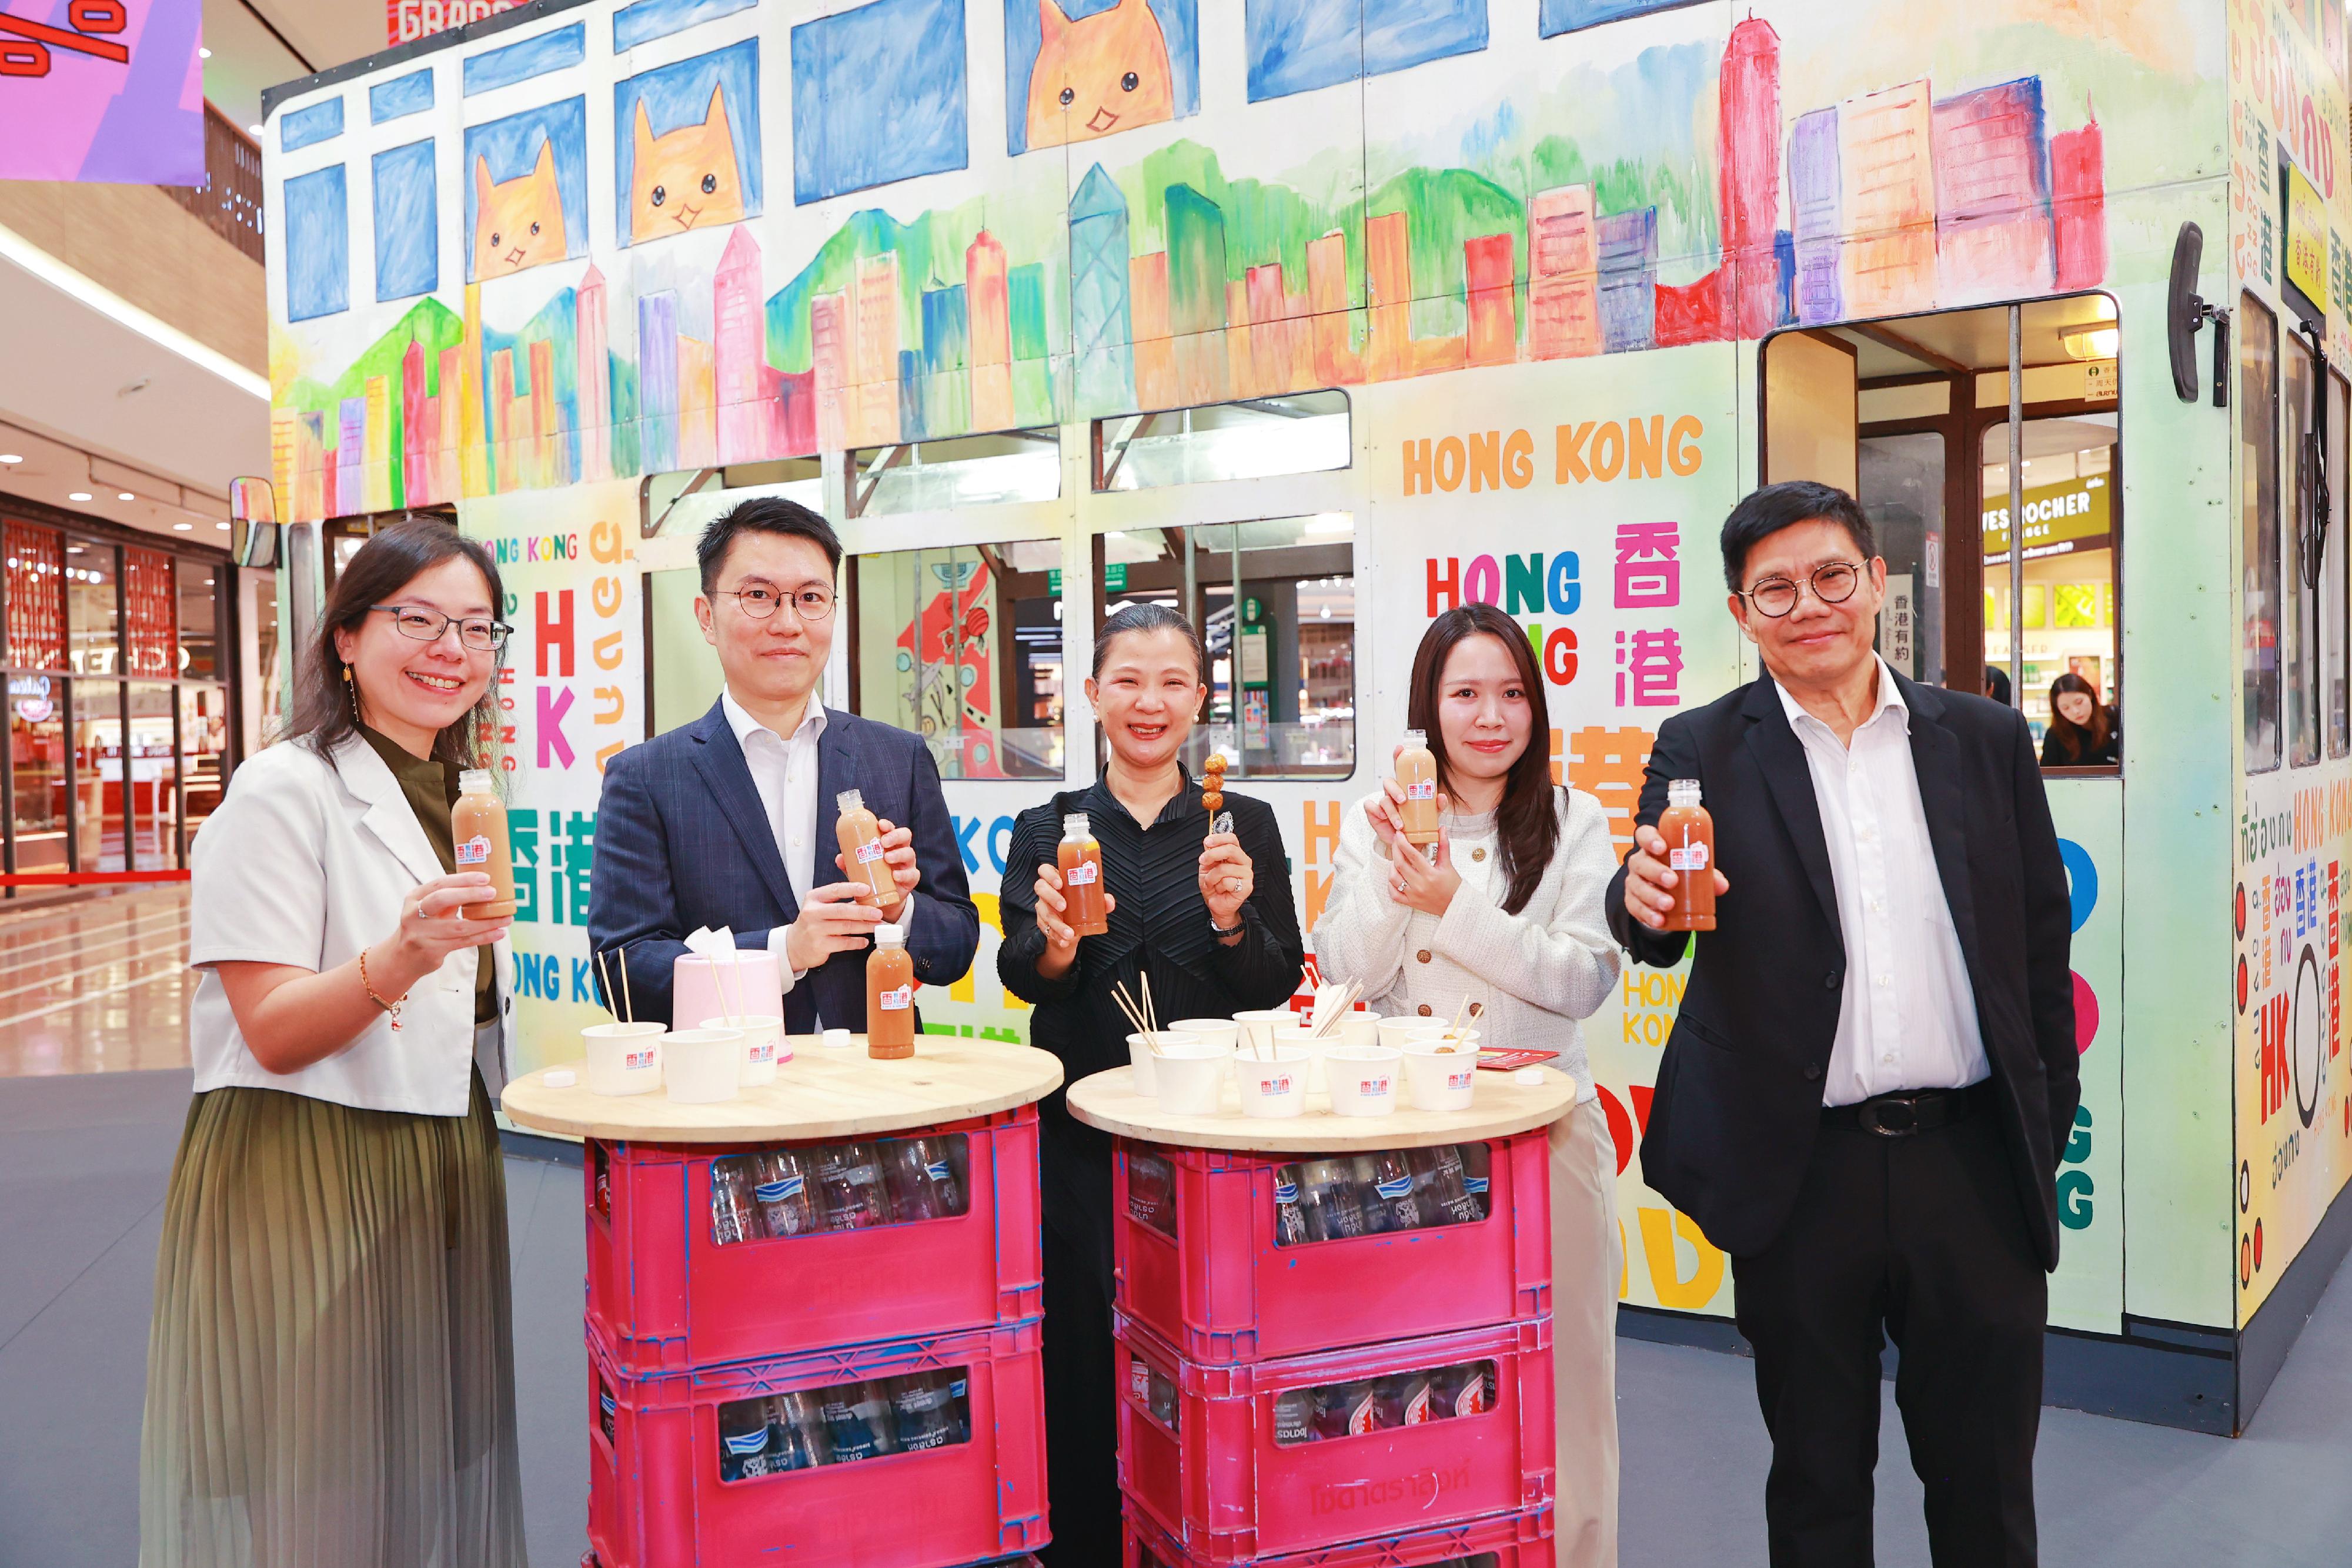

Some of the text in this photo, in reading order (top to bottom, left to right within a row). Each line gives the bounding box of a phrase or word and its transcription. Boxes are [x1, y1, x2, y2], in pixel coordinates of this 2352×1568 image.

[1403, 414, 1703, 496] HONG KONG
[2021, 491, 2090, 524] OCHER
[483, 534, 577, 564] ONG KONG
[1426, 551, 1581, 617] HONG
[1614, 521, 1684, 707] 香港
[1895, 594, 1909, 661] 香港有約
[2294, 790, 2324, 855] HONG
[2262, 874, 2271, 989] 香港
[2296, 856, 2317, 938] 香港
[1623, 970, 1688, 1008] HON
[2328, 860, 2340, 1064] 香港
[2261, 989, 2290, 1126] HK
